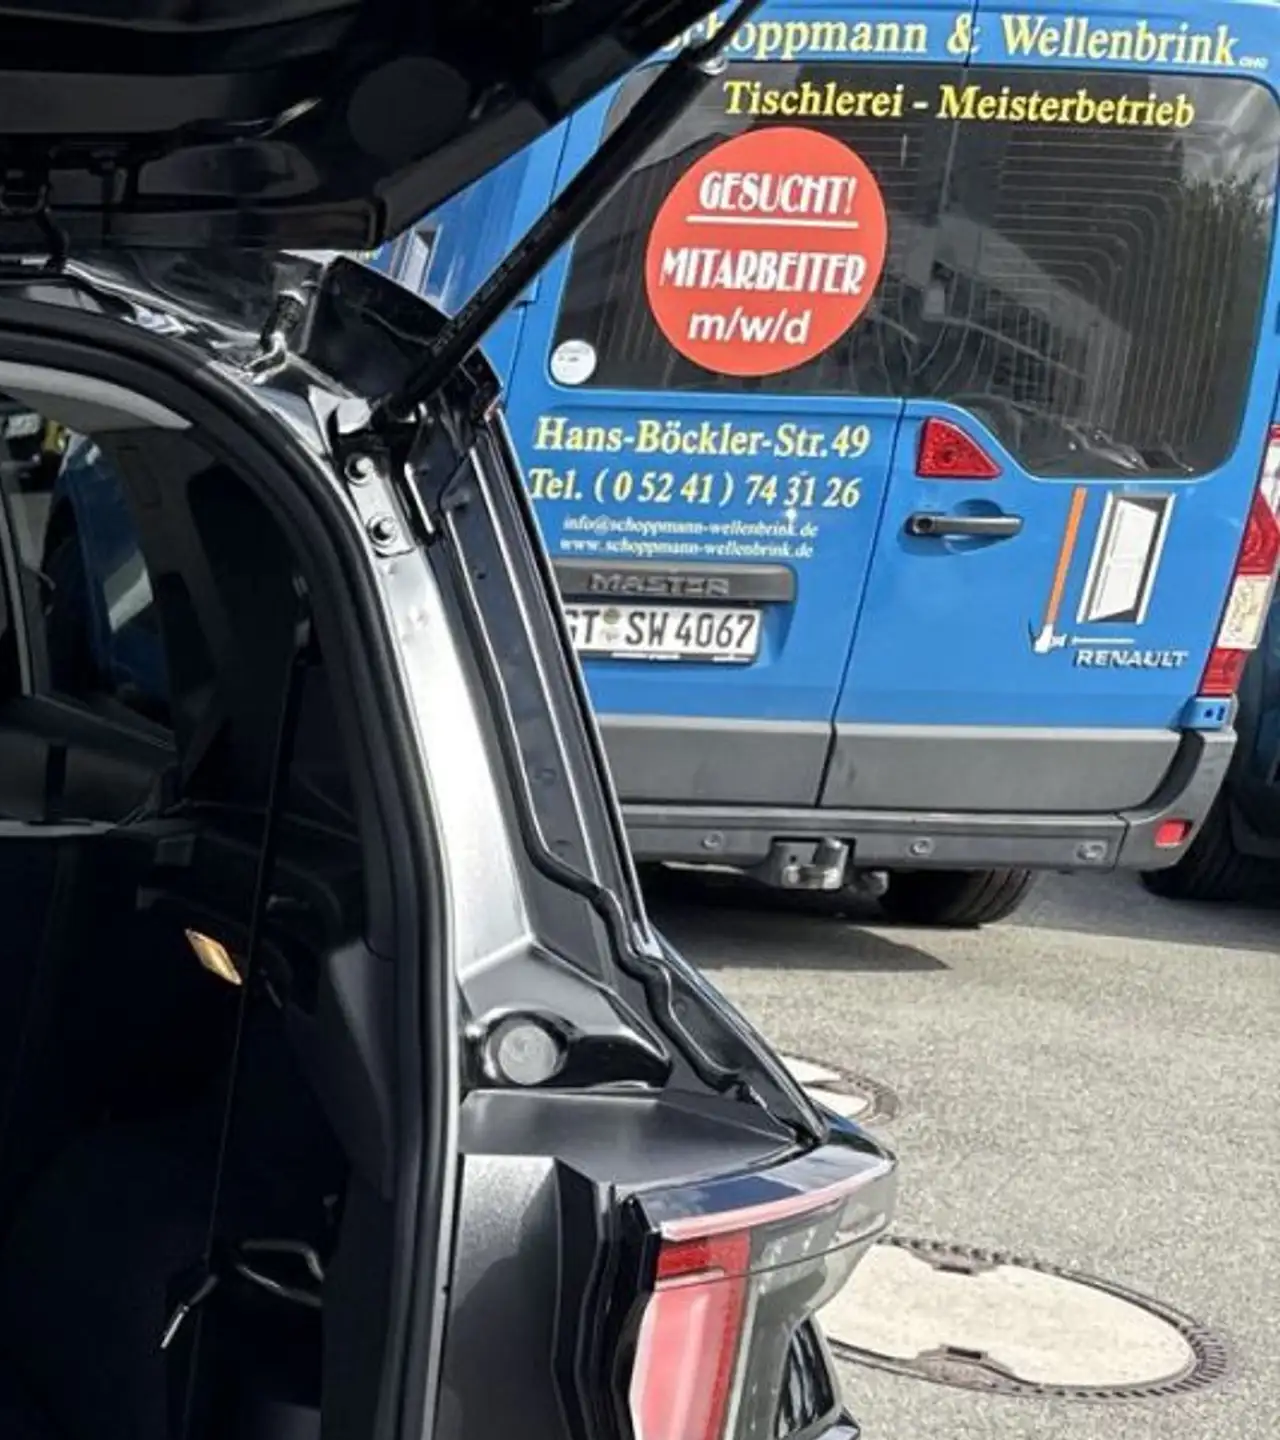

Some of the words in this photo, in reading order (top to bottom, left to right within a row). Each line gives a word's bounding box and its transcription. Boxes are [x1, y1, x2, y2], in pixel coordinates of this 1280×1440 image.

[946, 13, 980, 53] &
[1001, 12, 1240, 66] Wellenbrink
[723, 80, 905, 117] Tischlerei
[936, 83, 1195, 128] Meisterbetrieb
[698, 170, 858, 215] GESUCHT!
[659, 247, 868, 294] MITARBEITER
[688, 306, 812, 344] m/w/d
[528, 467, 583, 500] Tel.
[560, 538, 814, 559] www.schoppmann-wellenbrink.de
[588, 571, 730, 597] MASTER
[624, 610, 669, 646] SW
[674, 612, 756, 649] 4067
[1074, 650, 1189, 669] RENAULT
